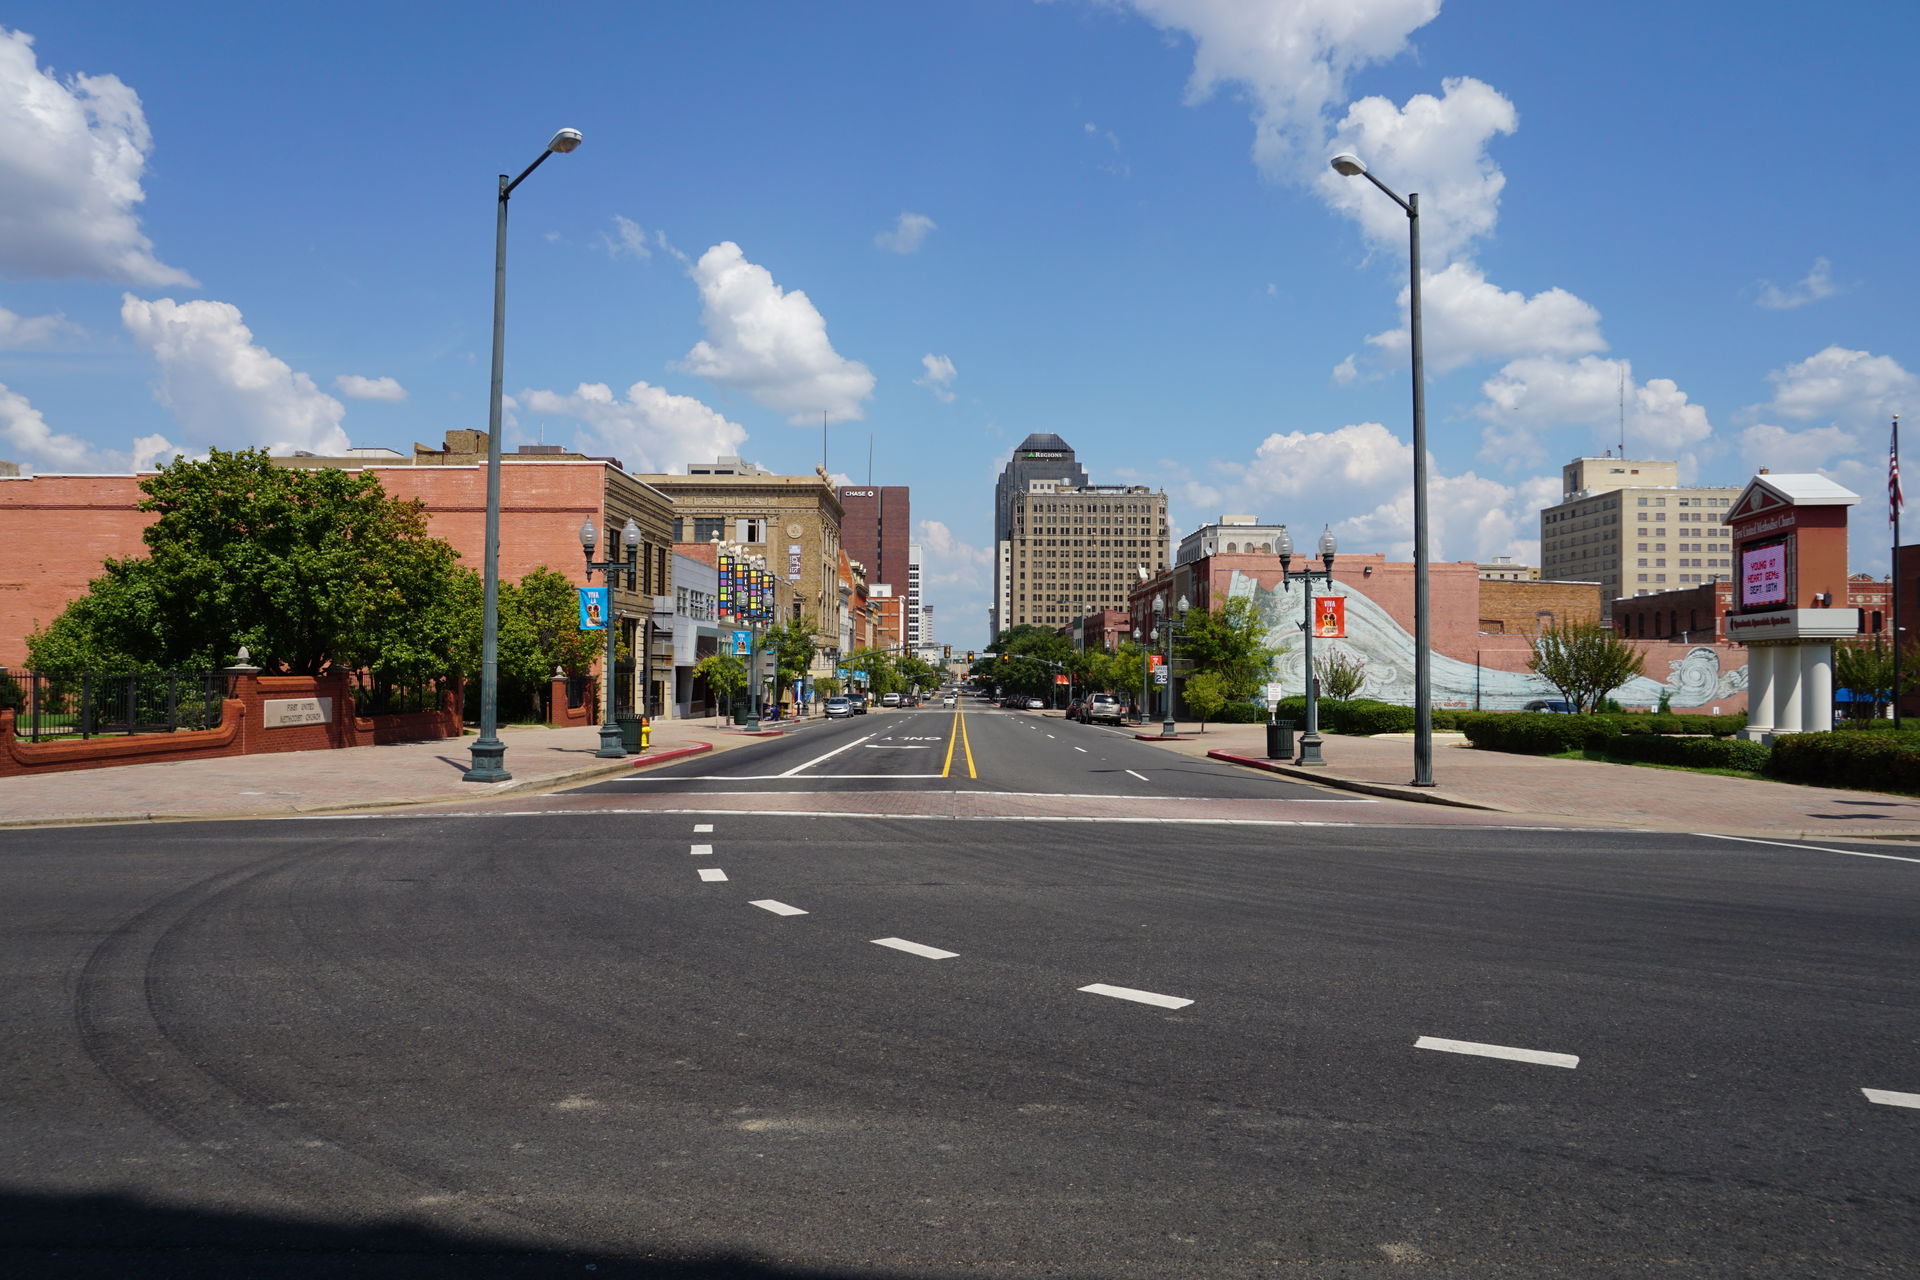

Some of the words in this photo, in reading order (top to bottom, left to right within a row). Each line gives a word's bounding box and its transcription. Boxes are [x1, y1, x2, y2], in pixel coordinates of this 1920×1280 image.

[1778, 512, 1795, 528] Church
[790, 555, 800, 574] lofts
[1750, 560, 1766, 570] YOUNG
